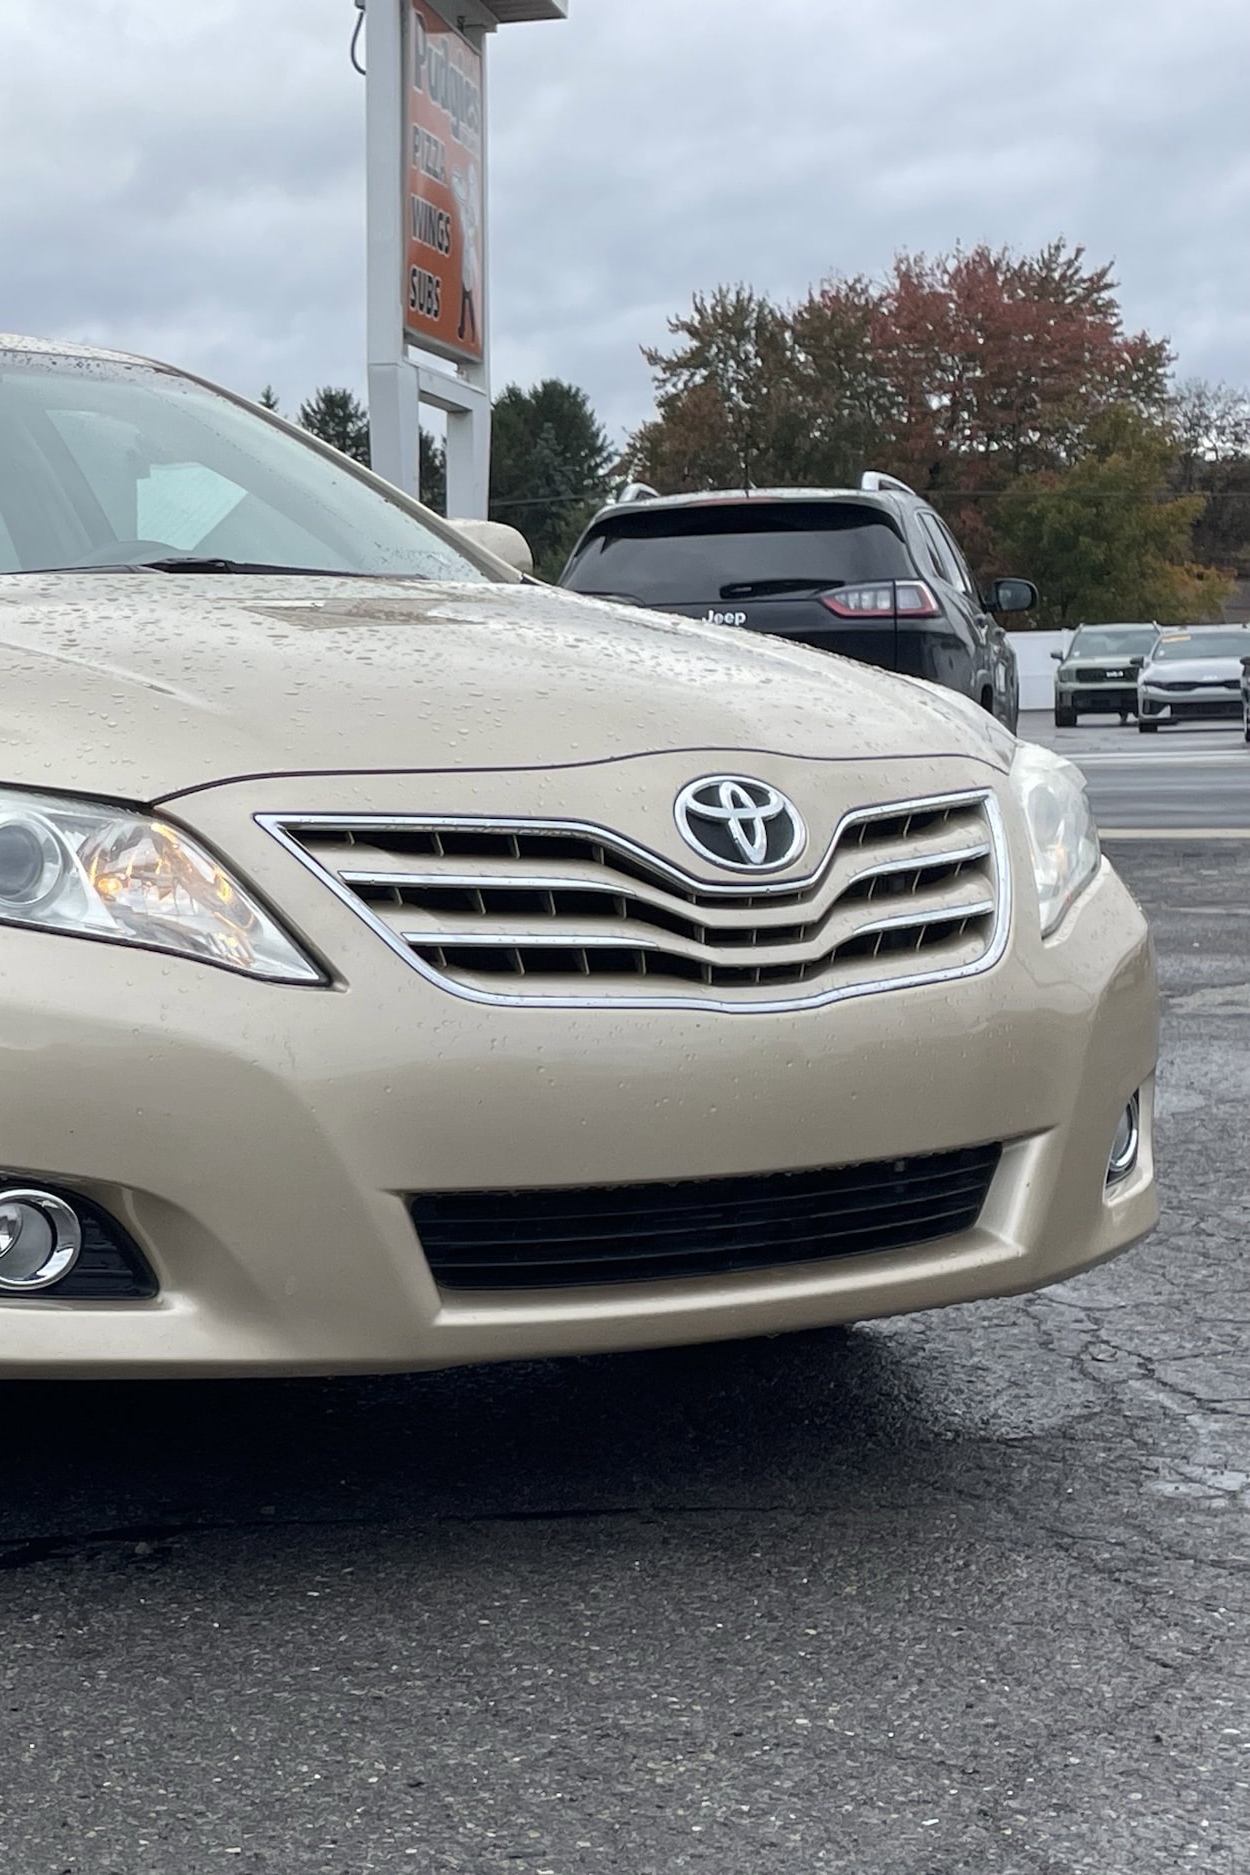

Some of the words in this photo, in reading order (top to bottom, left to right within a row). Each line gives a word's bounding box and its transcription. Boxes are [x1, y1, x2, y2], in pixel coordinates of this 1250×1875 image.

[412, 122, 448, 188] PIZZA
[411, 195, 451, 256] WINGS
[410, 266, 442, 320] SUBS
[702, 609, 747, 626] Jeep
